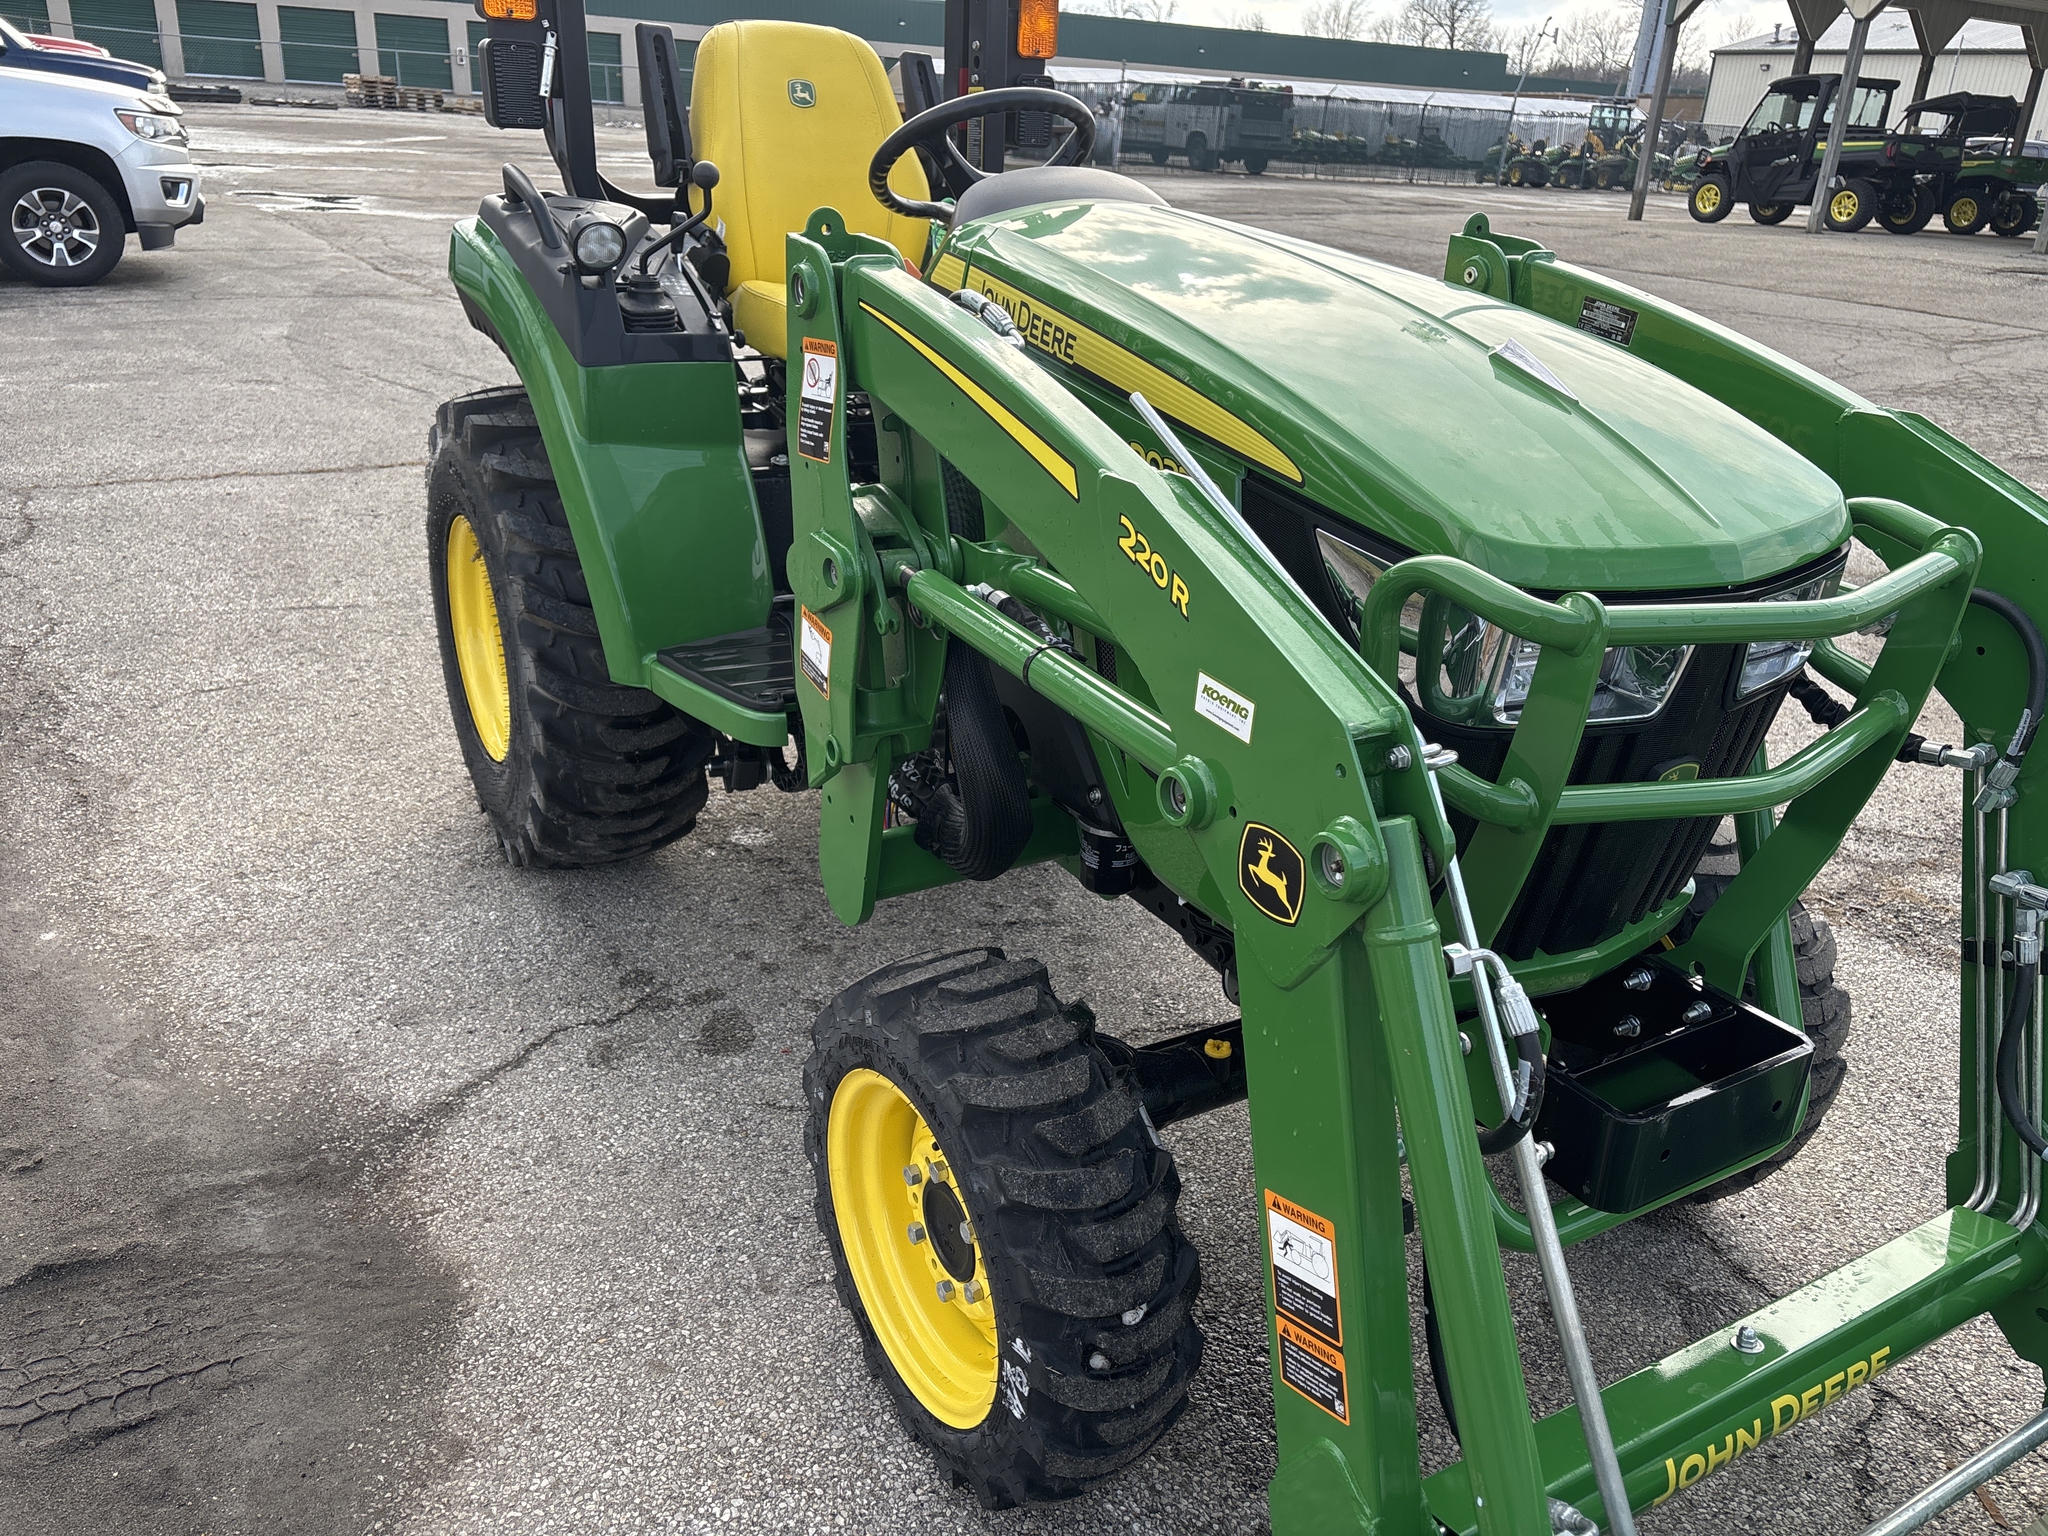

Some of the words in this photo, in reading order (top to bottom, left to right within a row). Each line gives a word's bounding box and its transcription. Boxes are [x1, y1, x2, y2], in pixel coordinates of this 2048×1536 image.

[808, 341, 836, 355] WARNING
[1016, 299, 1078, 361] DEERE
[1117, 512, 1170, 590] 220
[808, 613, 831, 642] WARNING
[1282, 1201, 1326, 1234] WARNING
[1293, 1330, 1337, 1366] WARNING
[1653, 1418, 1763, 1507] JOHN
[1769, 1345, 1891, 1438] DEERE
